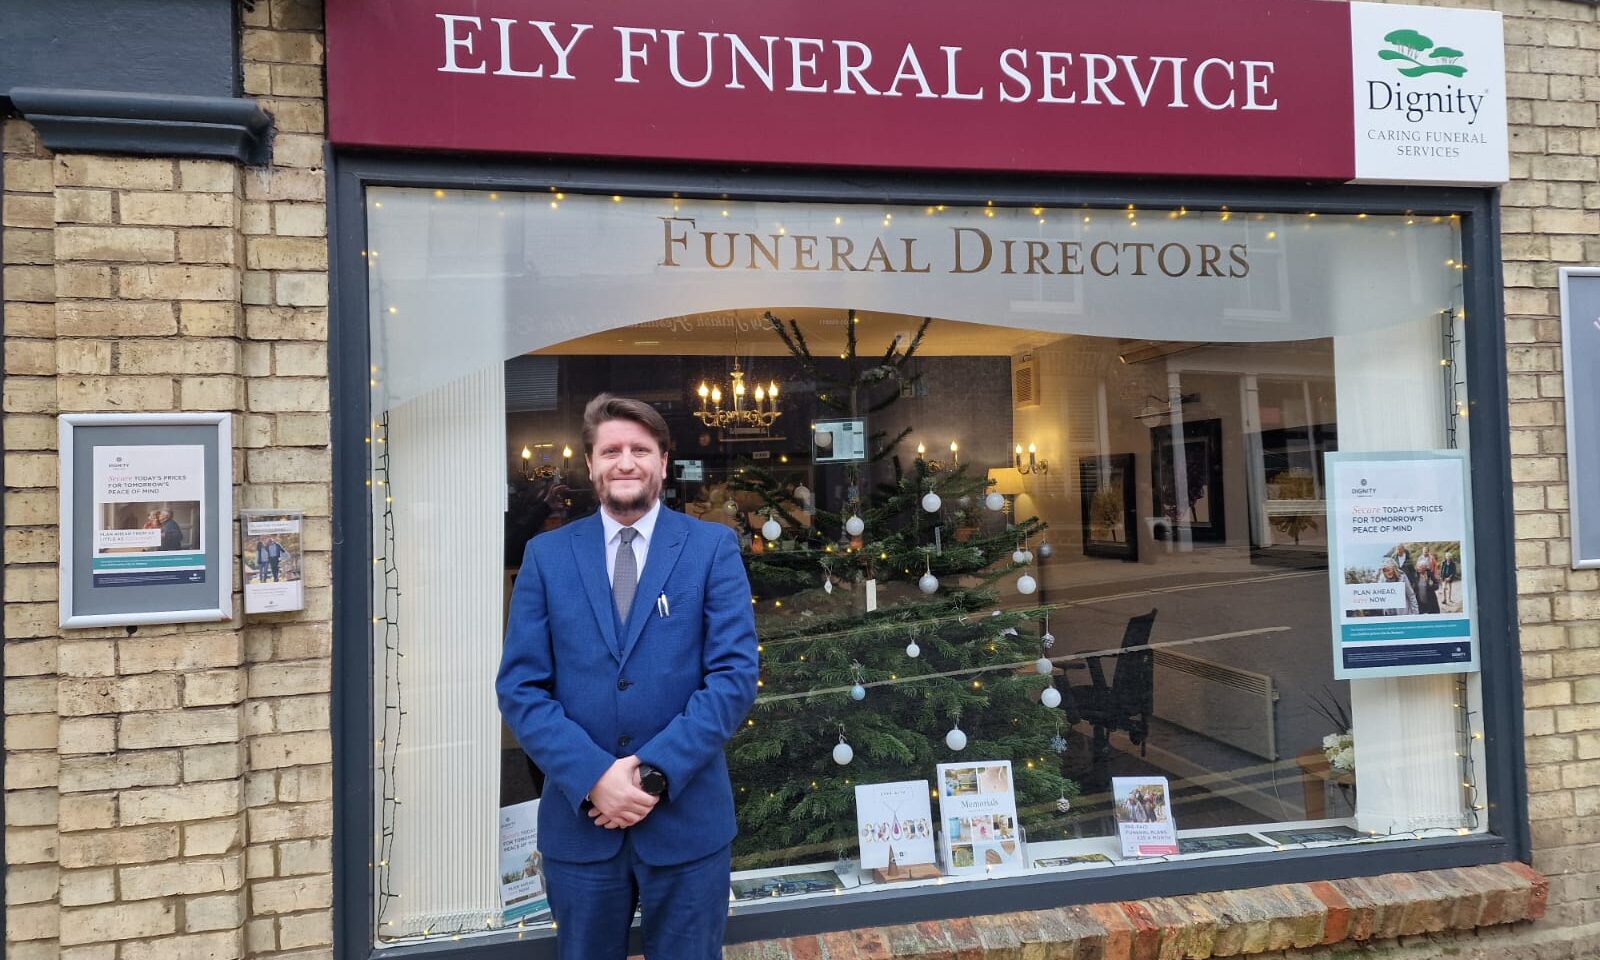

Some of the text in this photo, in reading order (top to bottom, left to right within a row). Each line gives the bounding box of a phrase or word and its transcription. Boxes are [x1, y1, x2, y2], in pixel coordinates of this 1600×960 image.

[435, 13, 1279, 111] ELY FUNERAL SERVICE
[1366, 80, 1484, 125] Dignity
[1367, 129, 1488, 144] CARING FUNERAL
[1397, 145, 1460, 158] SERVICES
[657, 216, 1250, 279] FUNERAL DIRECTORS
[1371, 515, 1424, 523] TOMORROW'S
